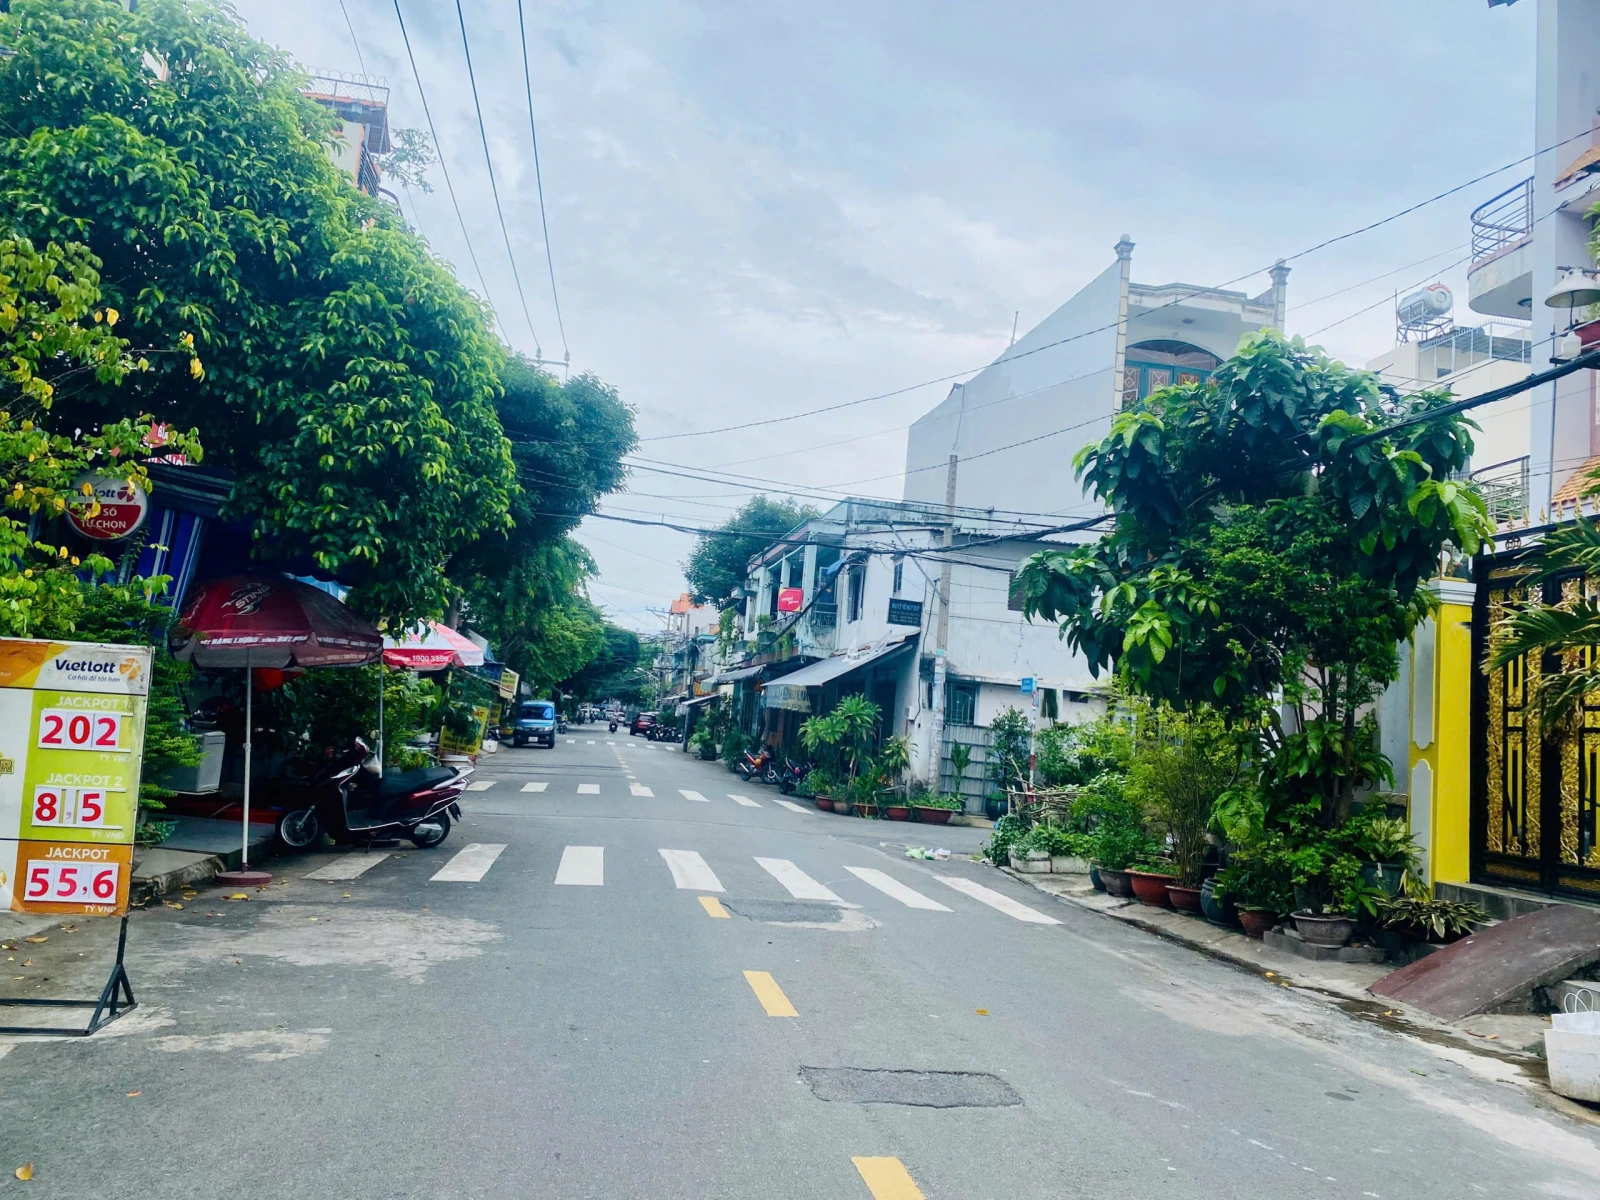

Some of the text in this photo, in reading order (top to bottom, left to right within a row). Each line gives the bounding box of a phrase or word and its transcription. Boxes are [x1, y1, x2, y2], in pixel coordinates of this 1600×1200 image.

[103, 506, 117, 516] SỐ
[96, 519, 126, 531] CHỌN
[235, 584, 270, 609] STING
[412, 654, 430, 662] 1900
[55, 659, 116, 673] Vietlott
[56, 696, 121, 710] JACKPOT
[41, 714, 117, 747] 202
[46, 773, 122, 786] JACKPOT 2
[35, 792, 102, 822] 8,5
[45, 847, 110, 860] JACKPOT
[28, 868, 115, 899] 55,6
